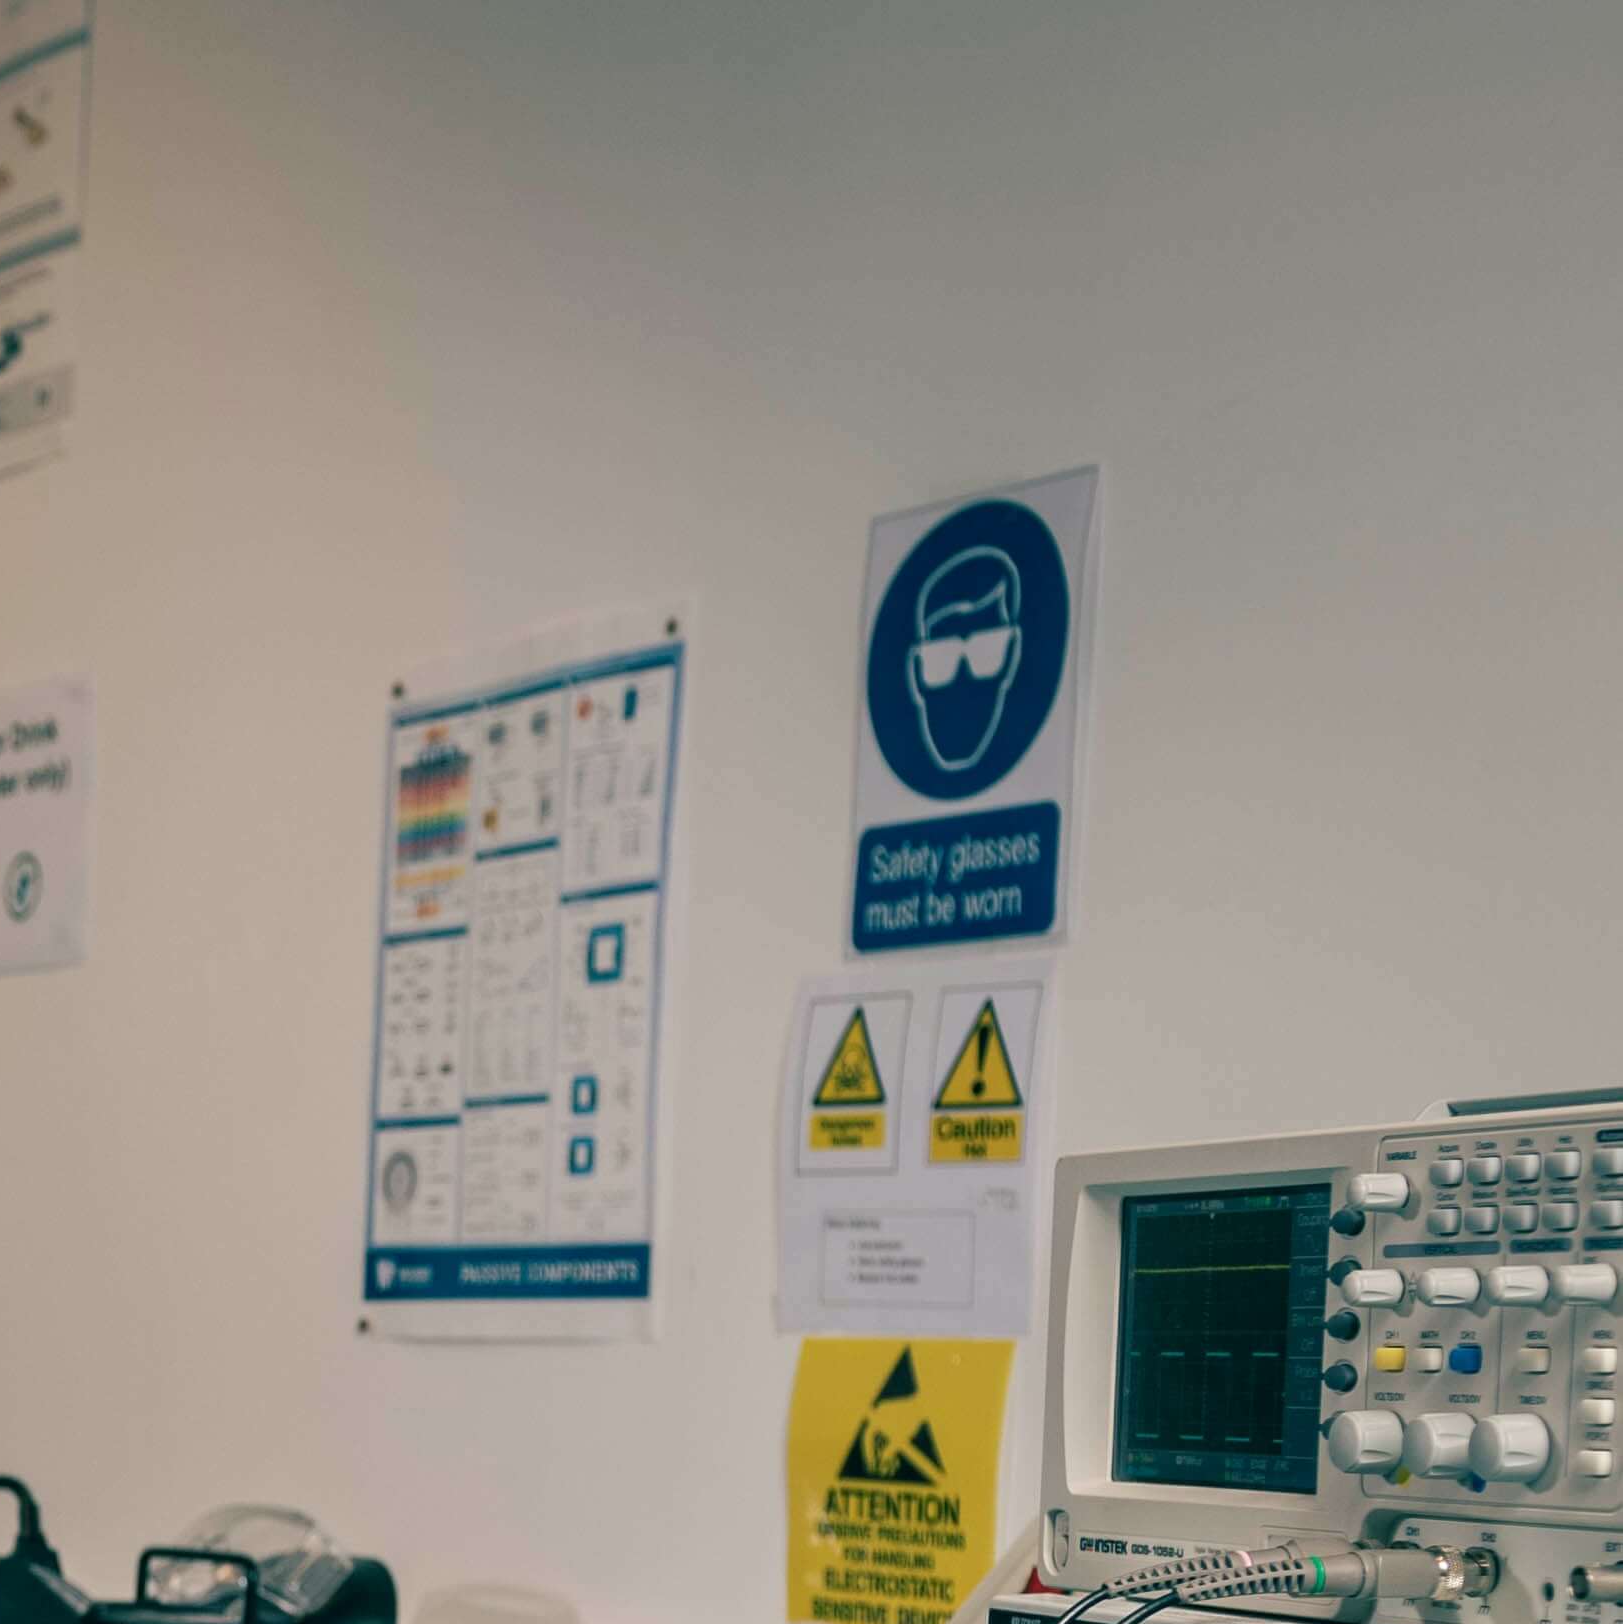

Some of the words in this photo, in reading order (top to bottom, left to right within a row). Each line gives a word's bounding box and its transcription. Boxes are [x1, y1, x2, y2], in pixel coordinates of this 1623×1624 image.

[870, 841, 944, 886] Safety
[949, 831, 1041, 884] glasses
[865, 893, 921, 932] must
[925, 888, 955, 926] be
[964, 884, 1023, 921] worn
[936, 1116, 1017, 1143] Caution
[459, 1260, 521, 1285] PASSIVE
[528, 1258, 640, 1284] COMPONENTS
[825, 1487, 961, 1525] ATTENTION
[844, 1547, 868, 1562] FOR
[872, 1549, 936, 1570] HANDLING
[824, 1565, 955, 1603] ELECTROSTATIC
